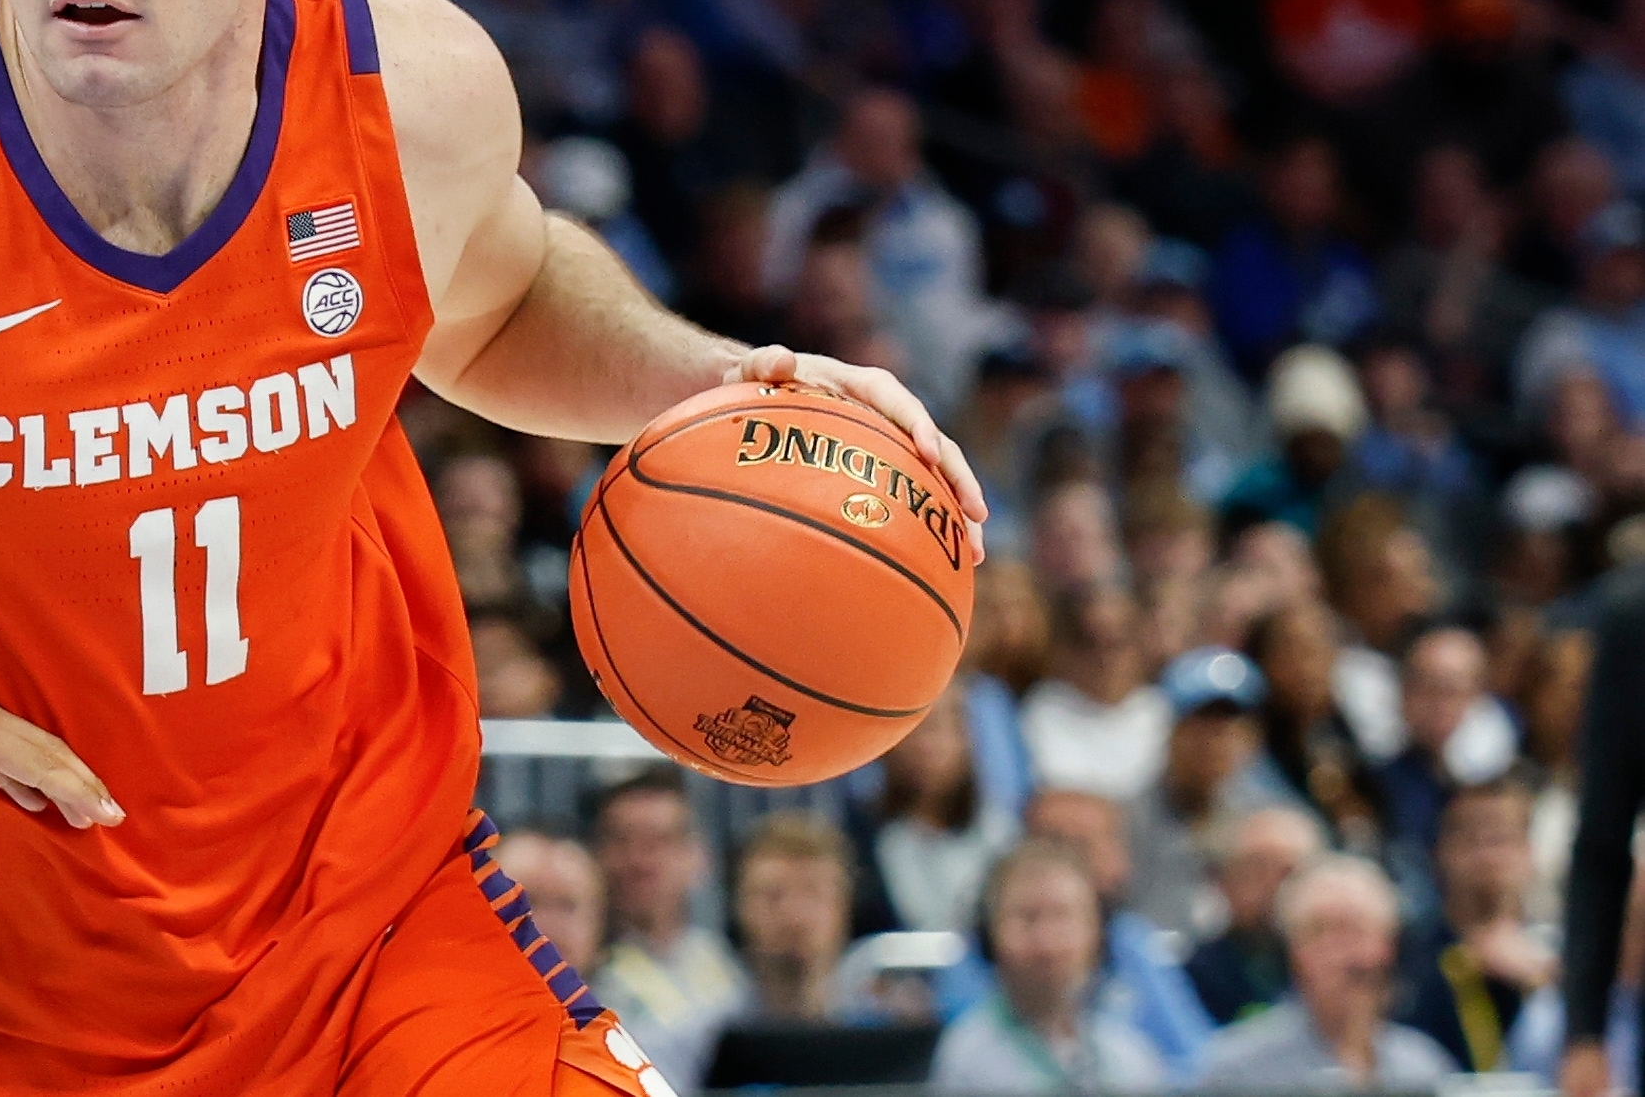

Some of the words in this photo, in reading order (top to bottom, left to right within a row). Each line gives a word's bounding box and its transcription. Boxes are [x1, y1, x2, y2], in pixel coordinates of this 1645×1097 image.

[314, 288, 355, 309] ACC
[736, 417, 965, 572] SPALDING
[129, 496, 250, 697] 11
